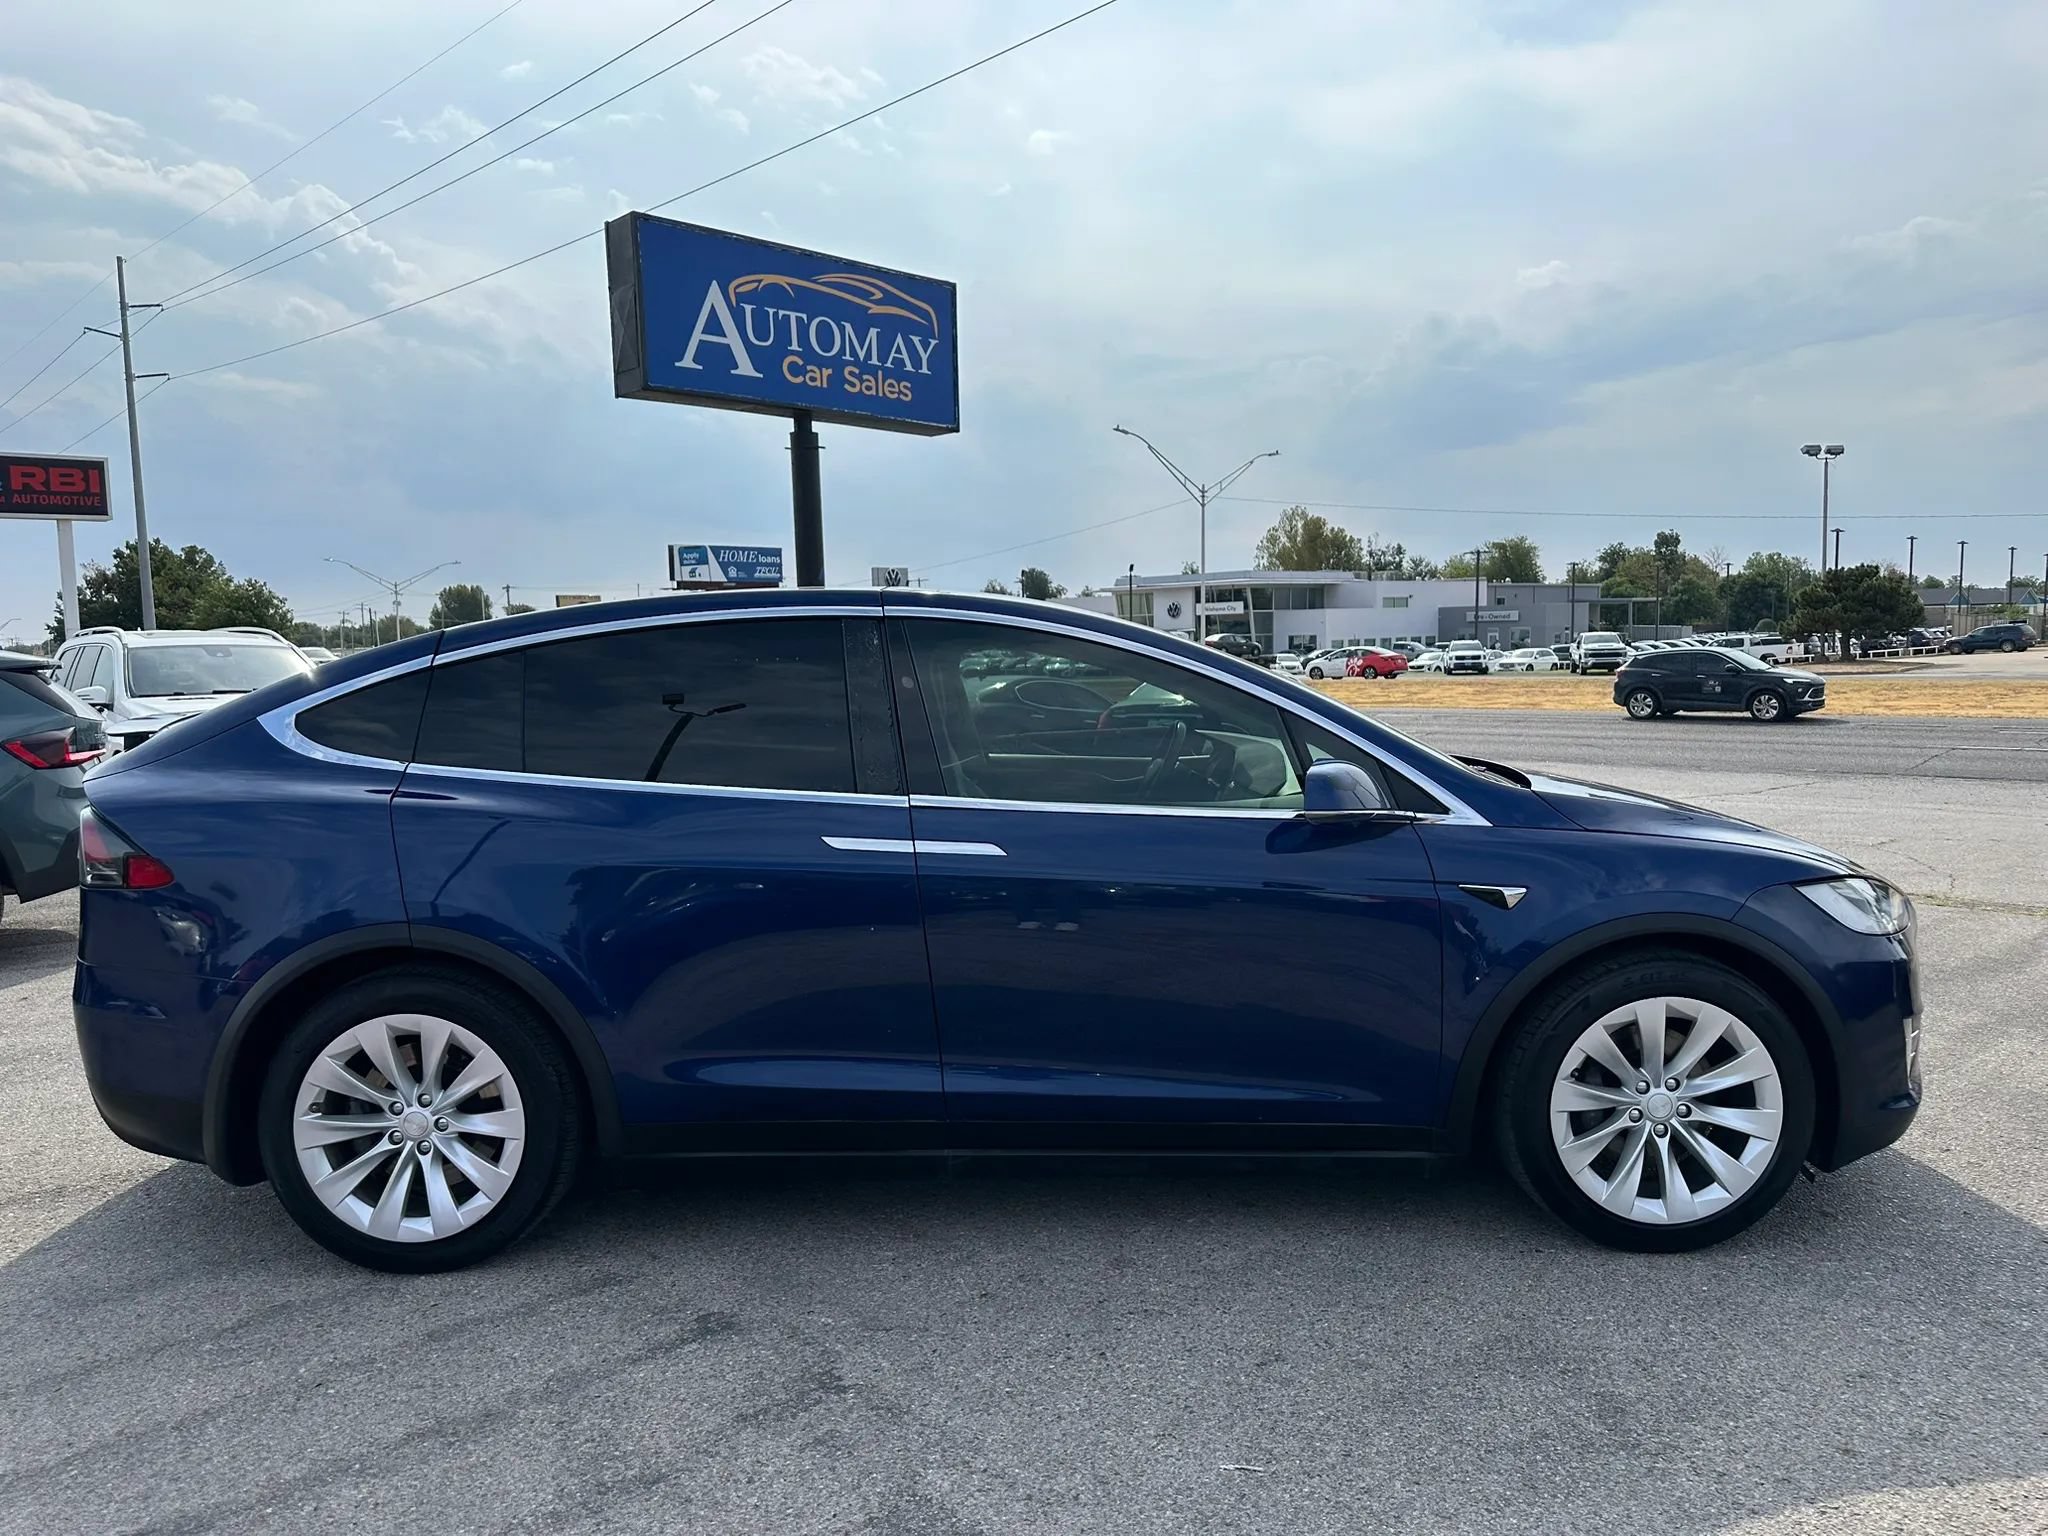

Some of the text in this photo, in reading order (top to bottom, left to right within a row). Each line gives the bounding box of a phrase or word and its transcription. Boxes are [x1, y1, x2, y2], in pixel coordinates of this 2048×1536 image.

[782, 355, 913, 401] Car Sales
[9, 465, 101, 493] RBI
[12, 493, 102, 507] AUTOMOTIVE
[719, 549, 781, 564] HOME loans
